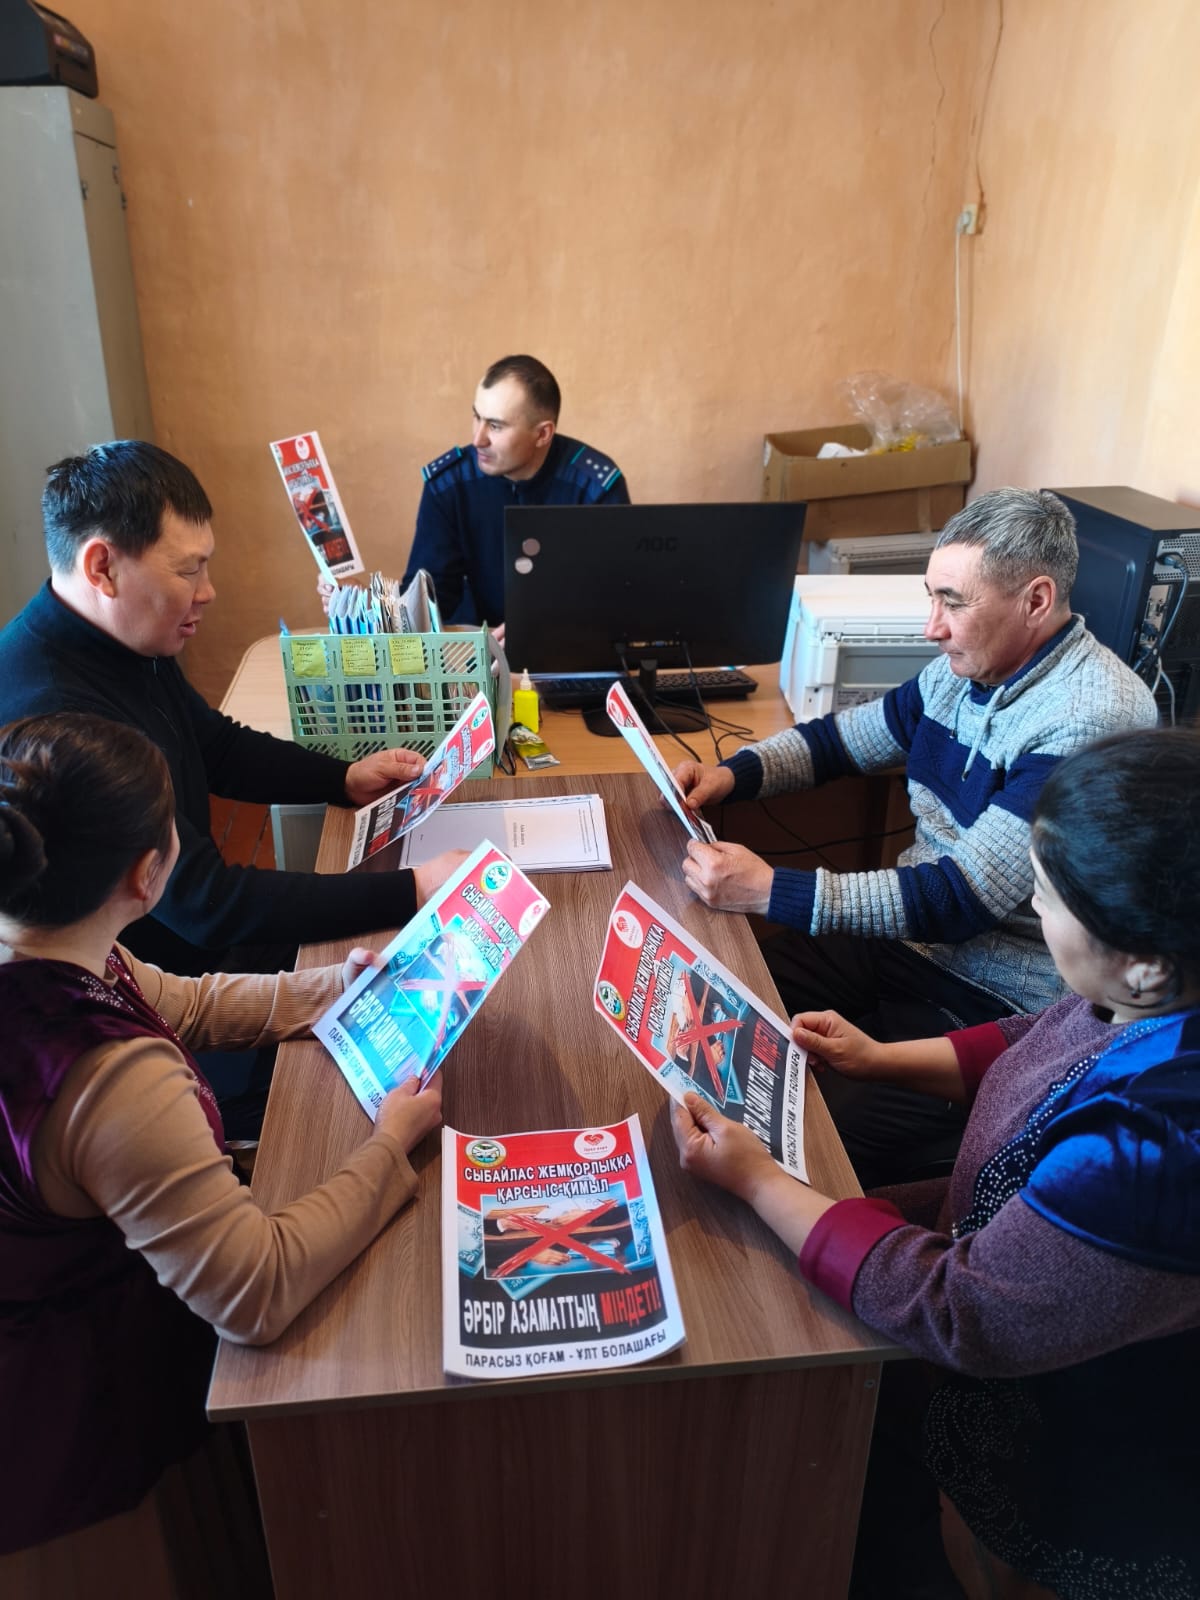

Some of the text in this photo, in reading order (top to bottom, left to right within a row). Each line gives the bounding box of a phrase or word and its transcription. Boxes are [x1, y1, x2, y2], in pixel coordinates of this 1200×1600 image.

[635, 536, 679, 552] AOC
[462, 883, 500, 925] СЫБАЙЛАС
[634, 922, 666, 993] ЖЕМҚОРЛЫҚҚА
[349, 989, 385, 1030] ӘРБІР
[625, 987, 648, 1043] СЫБАЙЛАС
[647, 999, 667, 1038] ҚАРСЫ
[365, 1011, 415, 1080] АЗАМАТТЫҢ
[789, 1050, 801, 1090] БОЛАШАҒЫ
[745, 1055, 780, 1127] АЗАМАТТЫҢ
[789, 1093, 799, 1107] ҰЛТ
[787, 1110, 798, 1137] ҚОҒАМ
[464, 1153, 633, 1183] СЫБАЙЛАС ЖЕМҚОРЛЫҚҚА
[788, 1134, 799, 1171] ПАРАСЫЗ
[496, 1178, 609, 1204] ҚАРСЫ ІС-ҚИМЫЛ
[463, 1278, 662, 1335] ӘРБІР АЗАМАТТЫҢ МІНДЕТІ!
[465, 1353, 522, 1368] ПАРАСЫЗ
[525, 1350, 565, 1368] ҚОҒАМ
[576, 1347, 598, 1361] ҰЛТ
[602, 1329, 666, 1358] БОЛАШАҒЫ
